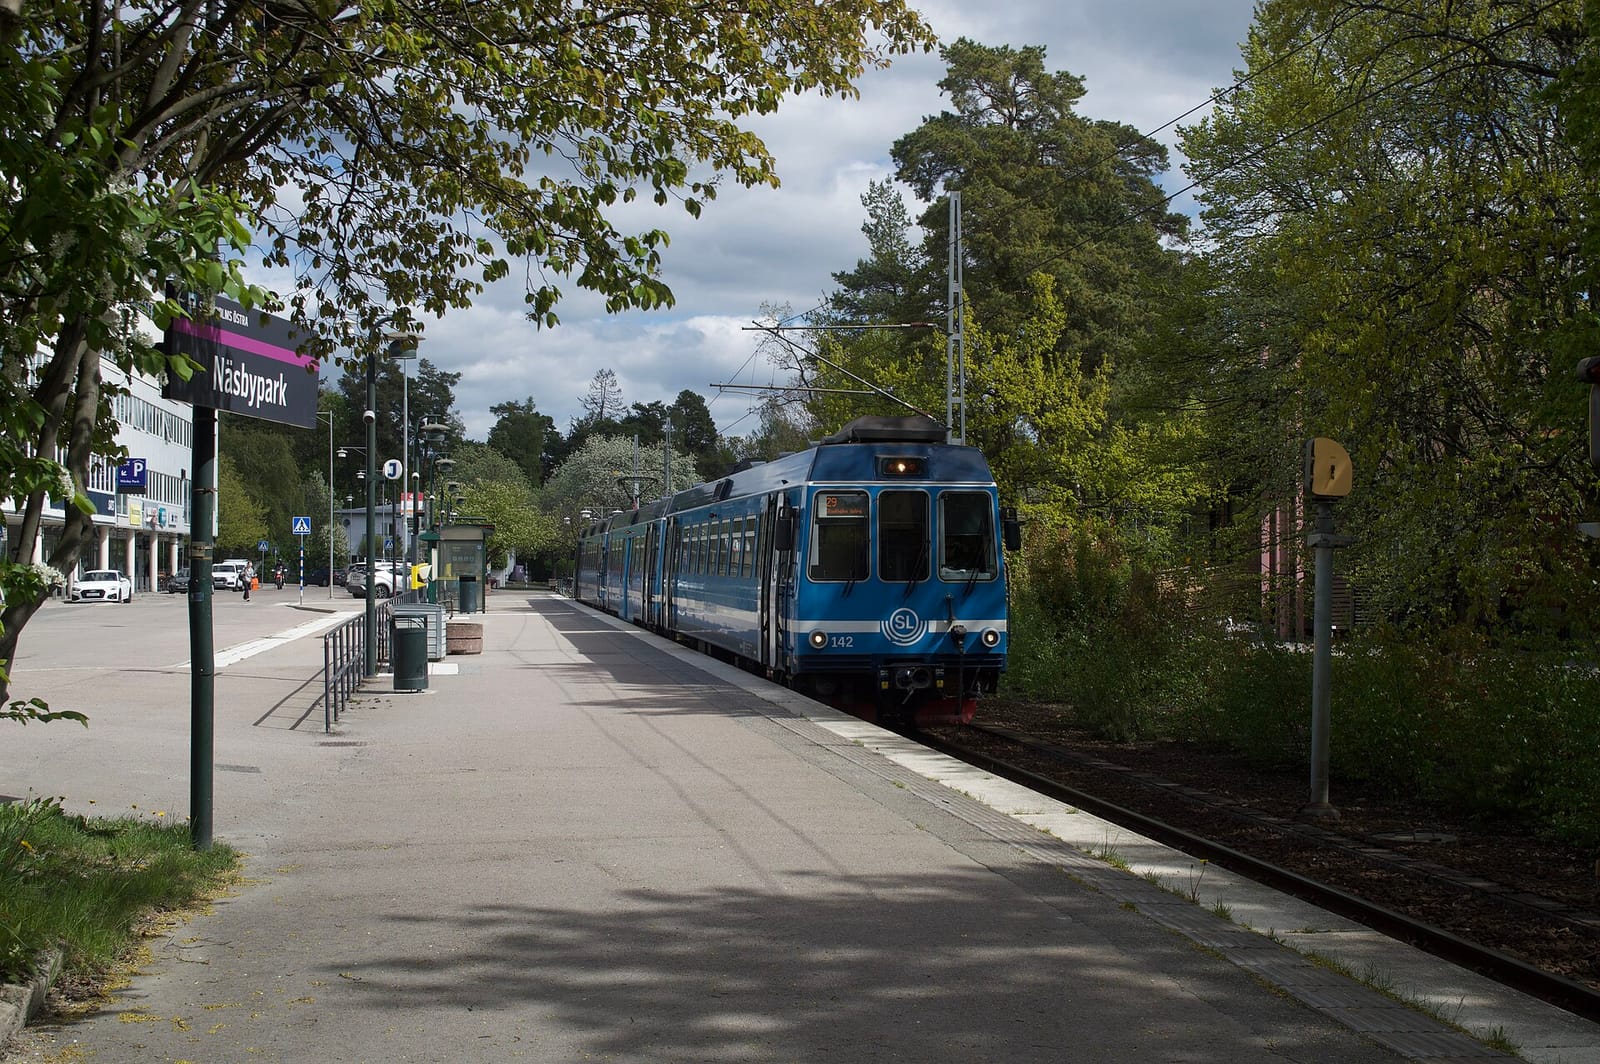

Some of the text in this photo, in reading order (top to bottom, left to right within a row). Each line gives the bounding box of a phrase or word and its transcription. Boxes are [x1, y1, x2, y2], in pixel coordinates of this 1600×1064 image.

[233, 310, 249, 327] ÖSTRA
[213, 354, 288, 409] Näsbypark
[133, 462, 143, 477] P
[387, 463, 397, 477] J
[826, 497, 838, 507] 29
[894, 615, 914, 629] SL
[831, 636, 854, 648] 142
